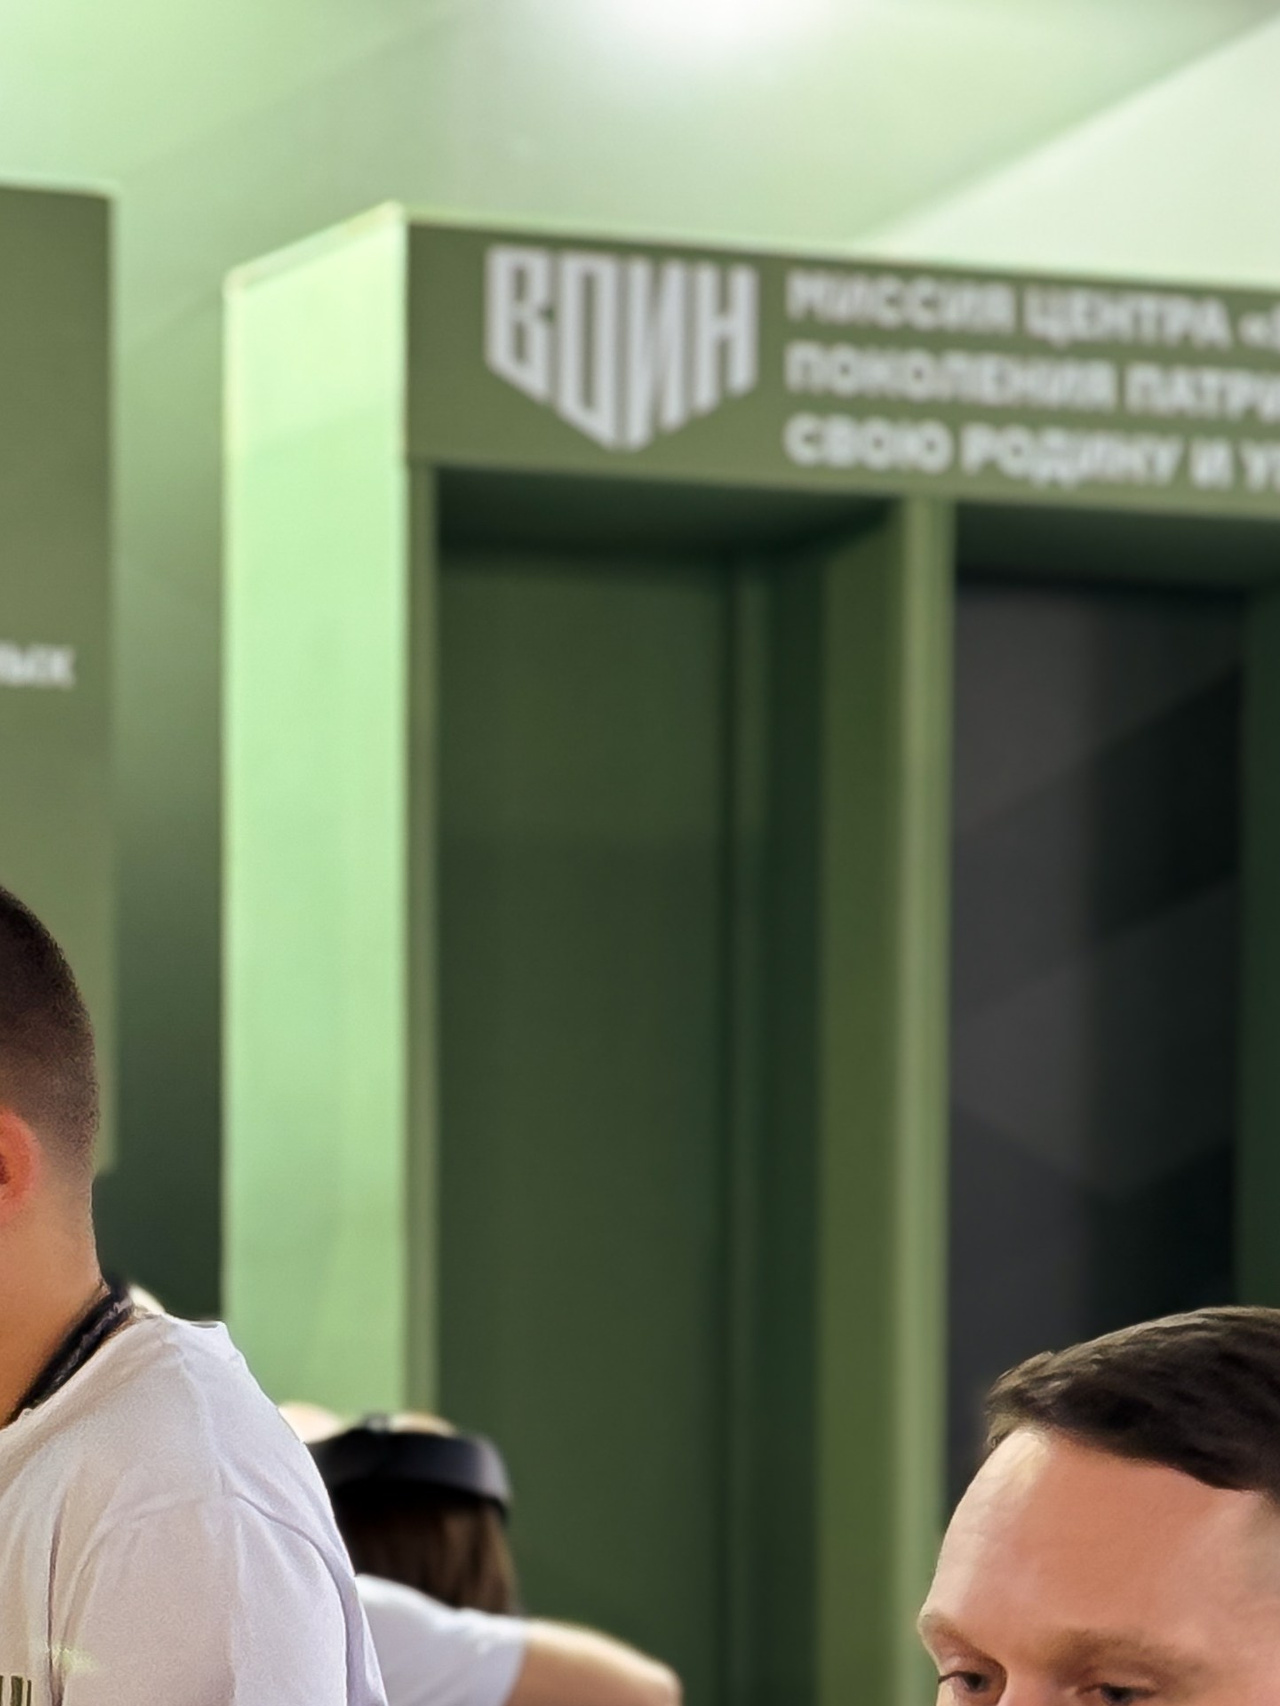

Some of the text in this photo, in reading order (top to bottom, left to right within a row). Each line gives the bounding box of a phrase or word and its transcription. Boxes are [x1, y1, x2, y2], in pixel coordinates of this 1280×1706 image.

[485, 244, 758, 452] ВОИН
[785, 268, 1016, 334] МИССИЯ
[1023, 284, 1234, 350] ЦЕНТРА
[784, 341, 1117, 413] ПОКОЛЕНИЯ
[783, 413, 954, 474] СВОЮ
[959, 421, 1184, 489] РОДИНУ
[1189, 436, 1234, 489] И
